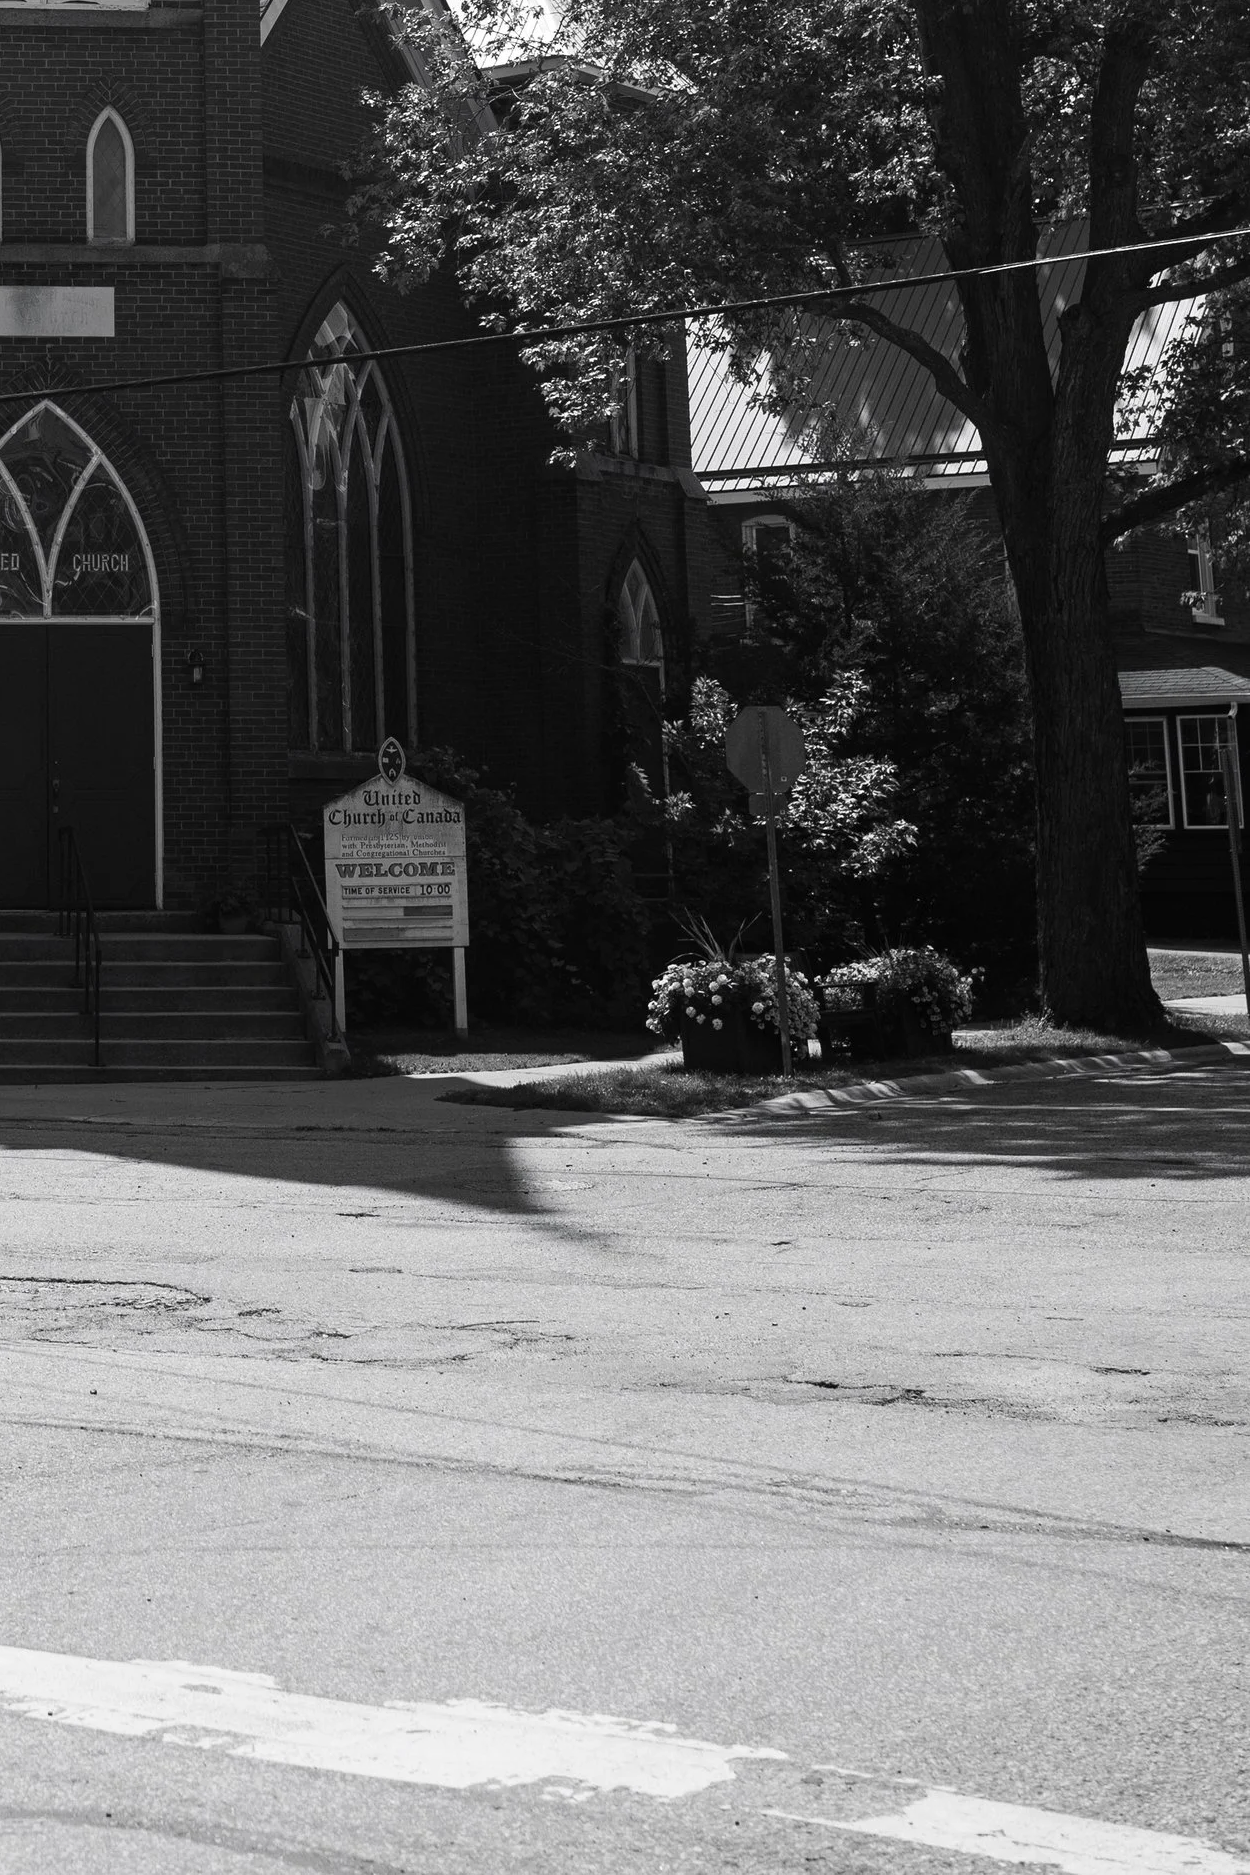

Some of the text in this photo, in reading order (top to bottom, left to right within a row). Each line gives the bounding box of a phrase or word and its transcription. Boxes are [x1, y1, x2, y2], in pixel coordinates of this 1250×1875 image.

[73, 554, 129, 572] CHURCH
[362, 789, 421, 806] United
[328, 807, 461, 828] Church of Canada
[341, 842, 357, 850] with
[341, 848, 446, 859] and Congregational Churches
[335, 861, 456, 879] WELCOME
[344, 887, 363, 895] TIME
[365, 887, 375, 895] OF
[378, 886, 411, 895] SERVICE
